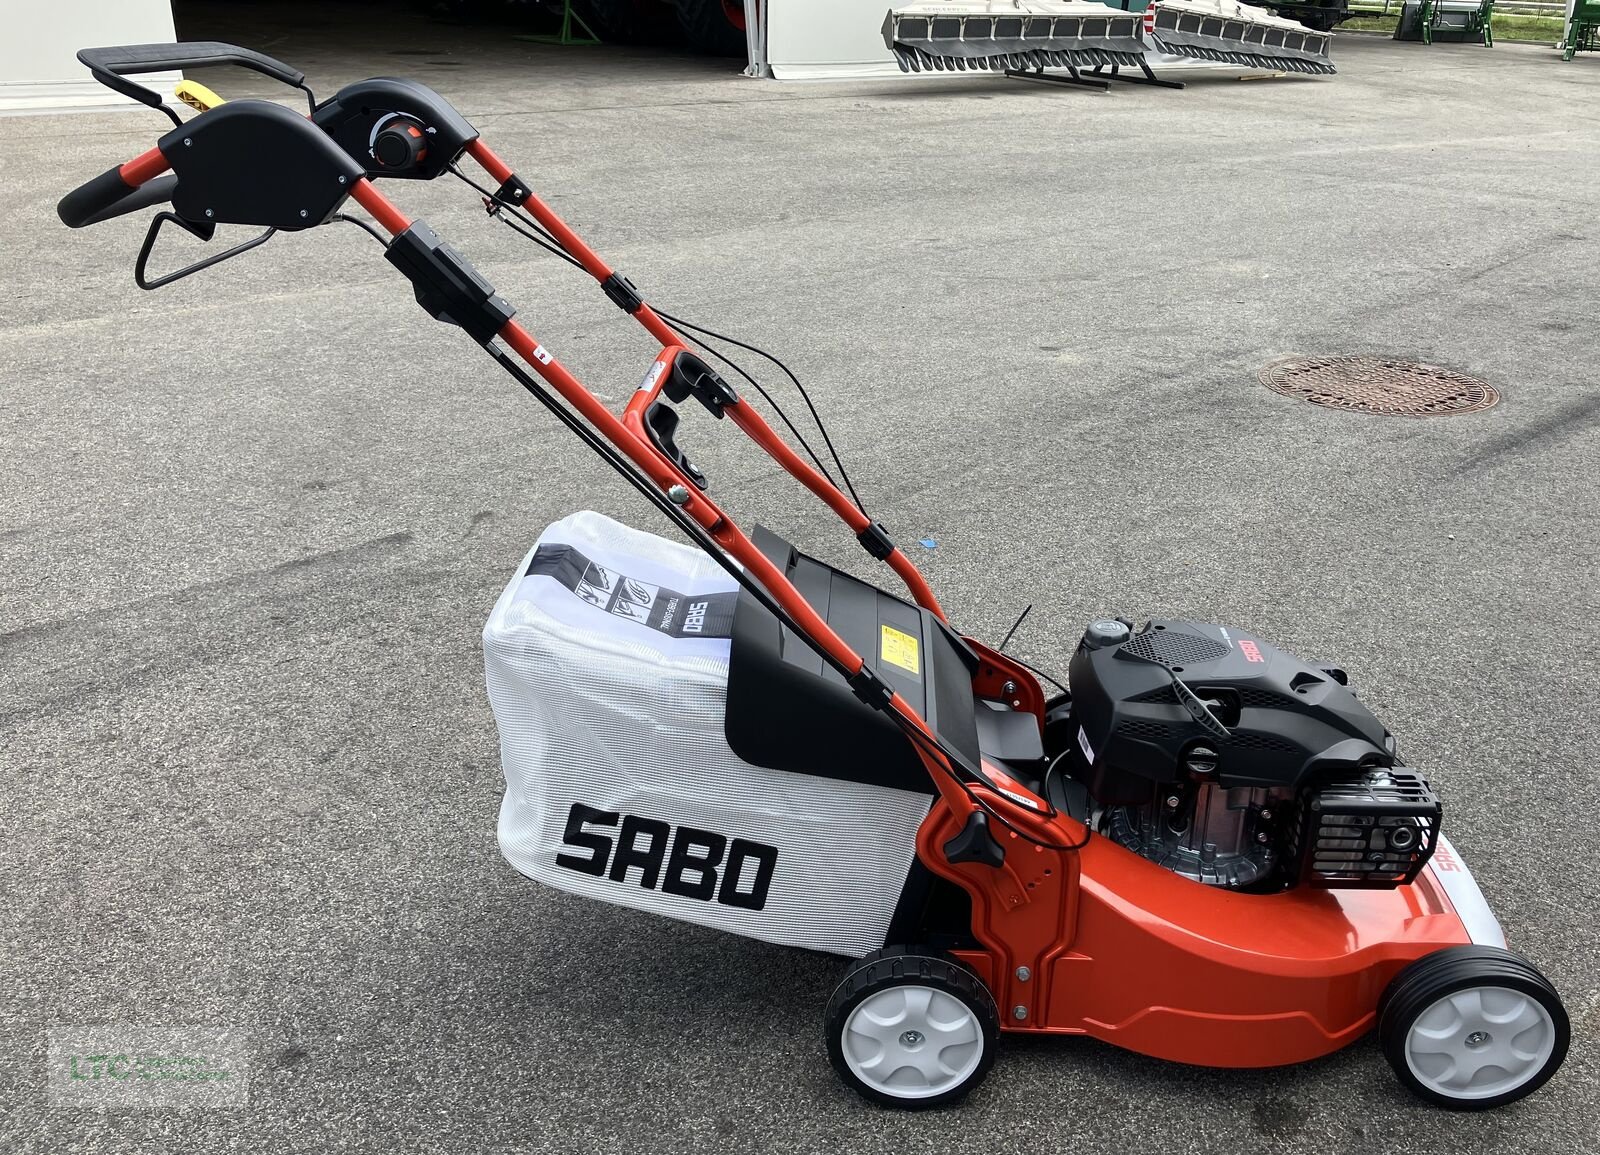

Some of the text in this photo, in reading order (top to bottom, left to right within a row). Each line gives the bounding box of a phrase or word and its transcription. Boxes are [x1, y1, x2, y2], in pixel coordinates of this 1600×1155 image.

[682, 602, 709, 633] SABO
[1237, 640, 1265, 662] SABO
[555, 802, 779, 911] SABO
